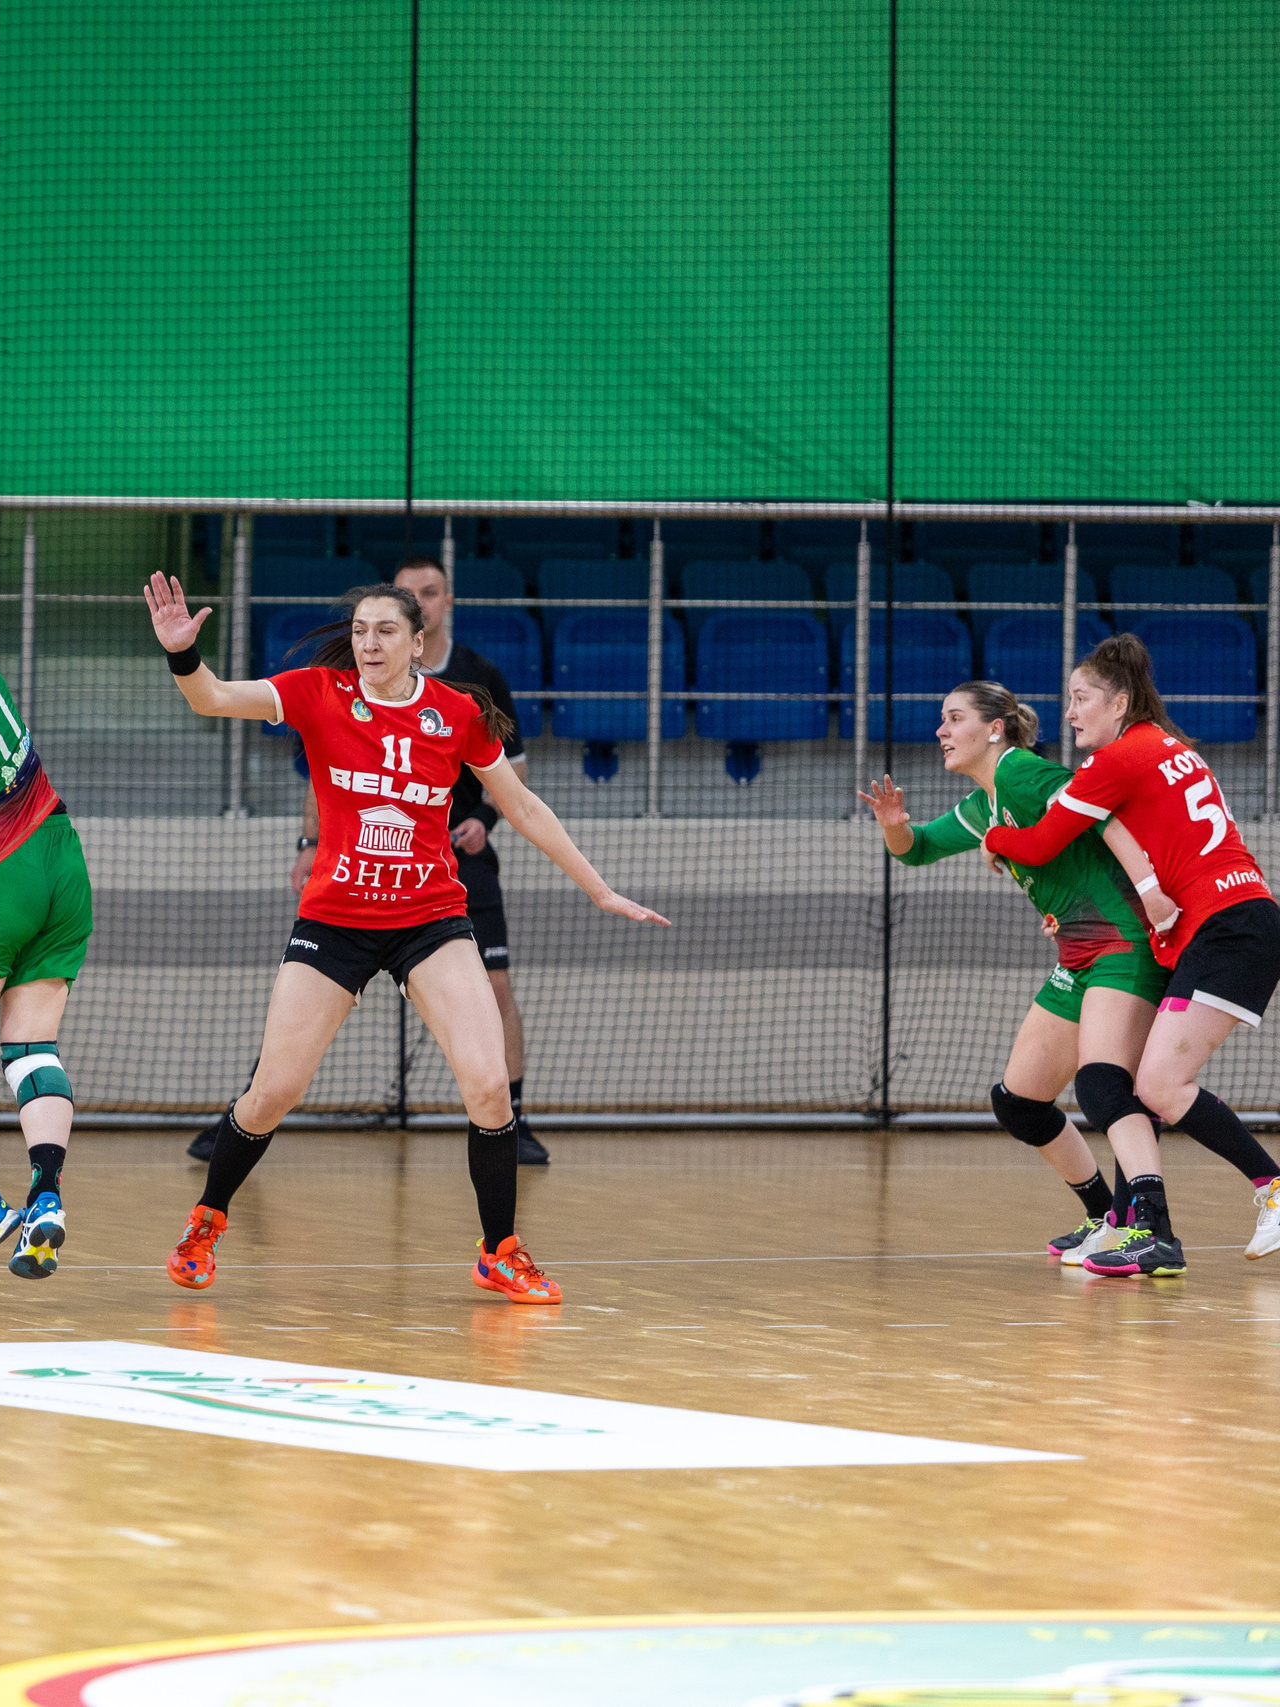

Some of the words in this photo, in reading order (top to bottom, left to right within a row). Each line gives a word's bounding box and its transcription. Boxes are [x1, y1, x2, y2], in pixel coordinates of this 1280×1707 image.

[381, 734, 413, 774] 11
[328, 765, 451, 806] BELAZ
[331, 853, 436, 889] БНТУ
[363, 891, 397, 901] 1920
[289, 937, 319, 951] Kempa
